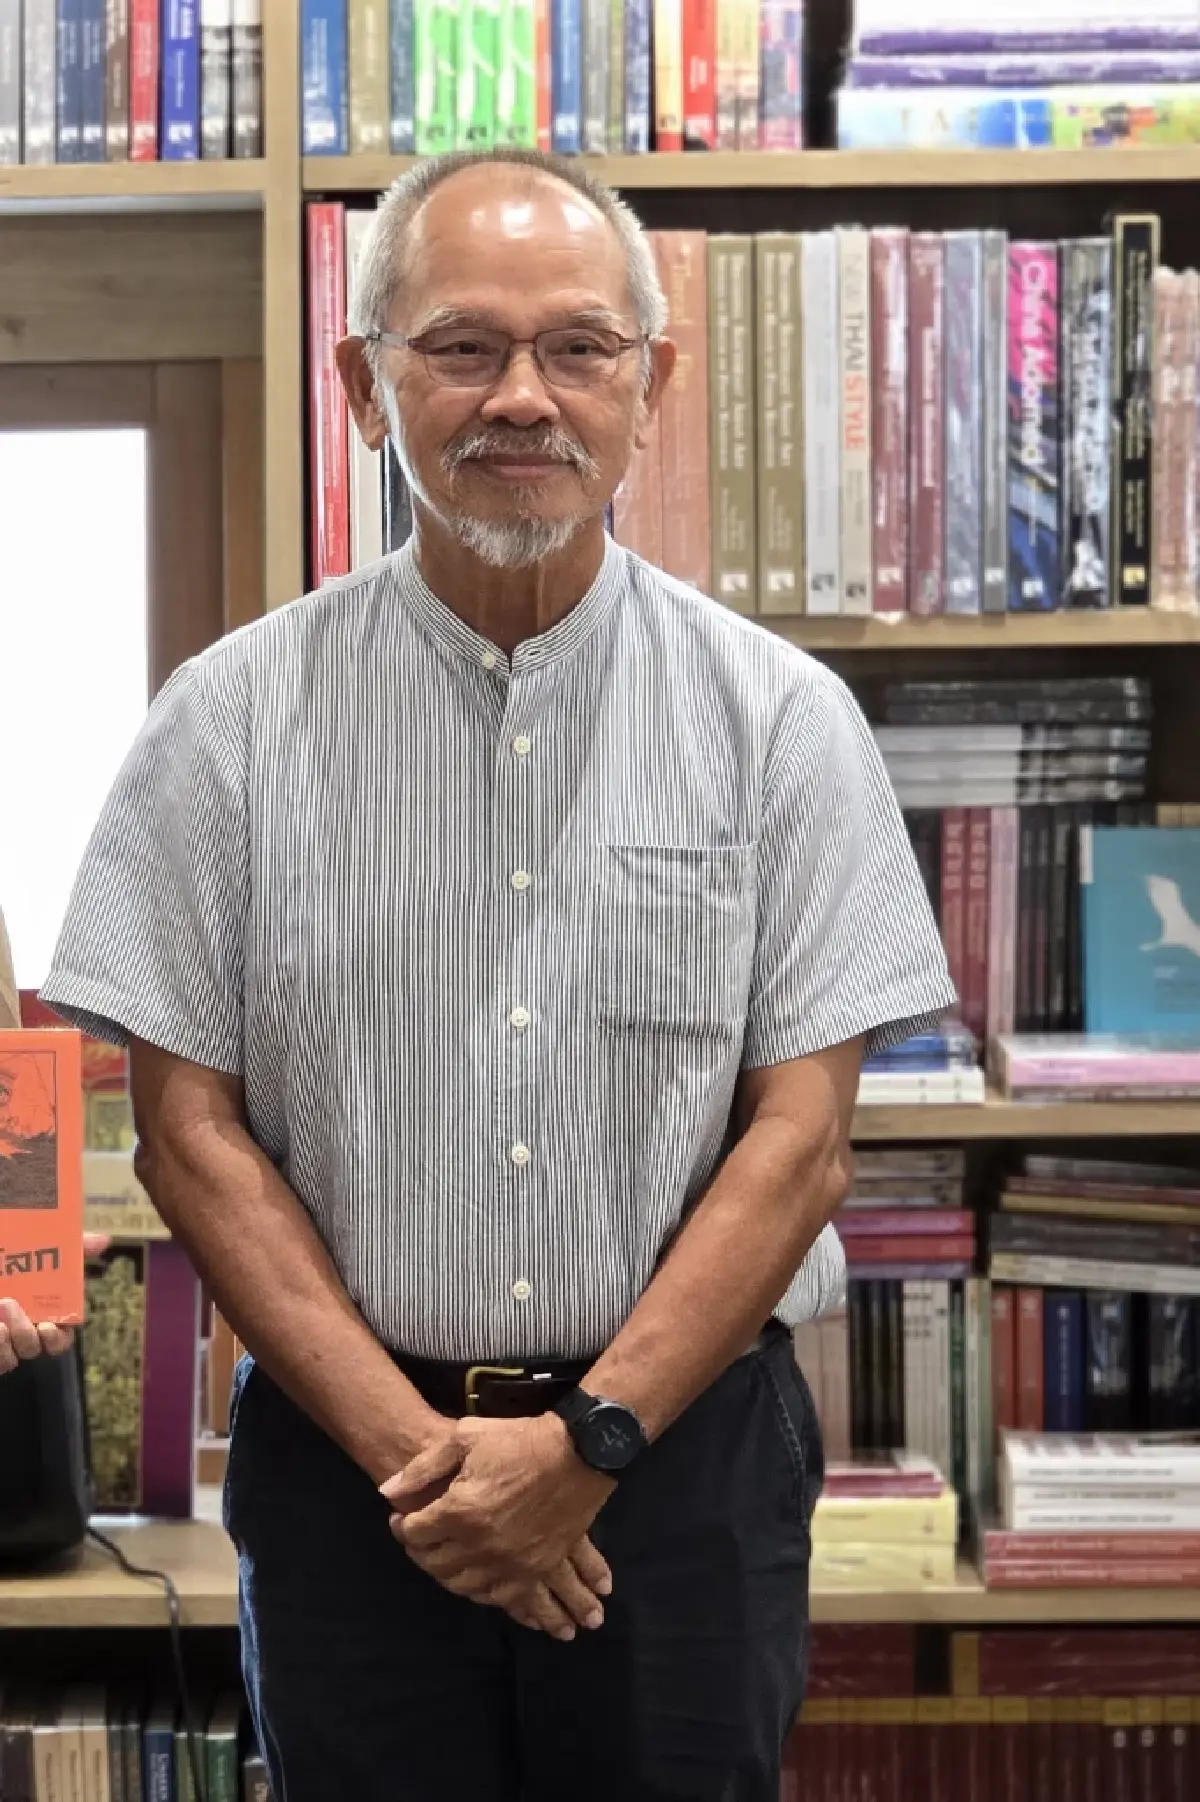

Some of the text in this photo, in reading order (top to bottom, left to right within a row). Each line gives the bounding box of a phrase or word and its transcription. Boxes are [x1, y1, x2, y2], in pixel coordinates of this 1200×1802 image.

[845, 312, 865, 372] THAI
[1021, 261, 1048, 464] China Adorned
[845, 374, 865, 451] STYLE
[0, 1247, 59, 1277] ลก
